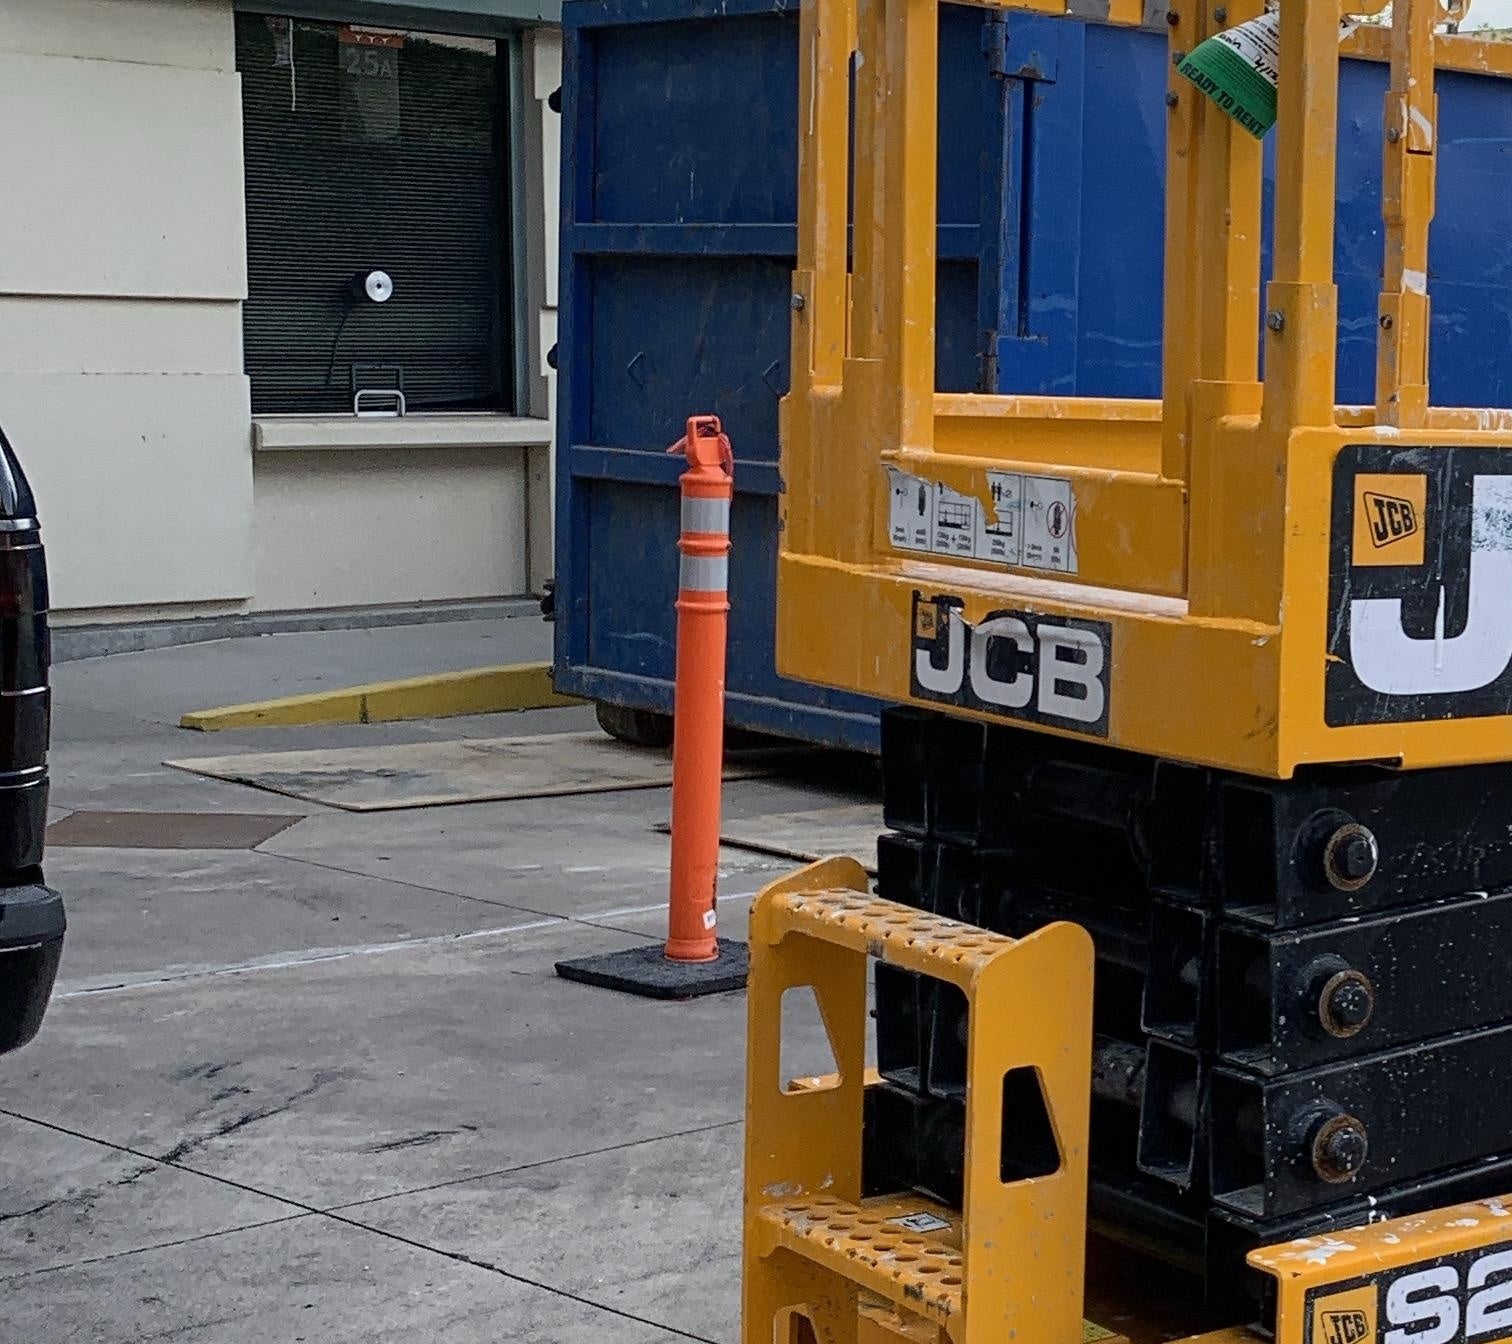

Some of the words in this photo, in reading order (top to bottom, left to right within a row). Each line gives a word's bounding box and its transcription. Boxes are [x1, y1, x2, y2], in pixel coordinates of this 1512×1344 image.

[1180, 63, 1220, 94] READY
[1217, 90, 1235, 109] TO
[1233, 105, 1265, 135] RENT
[1371, 498, 1415, 544] JCB
[917, 607, 1104, 722] JCB
